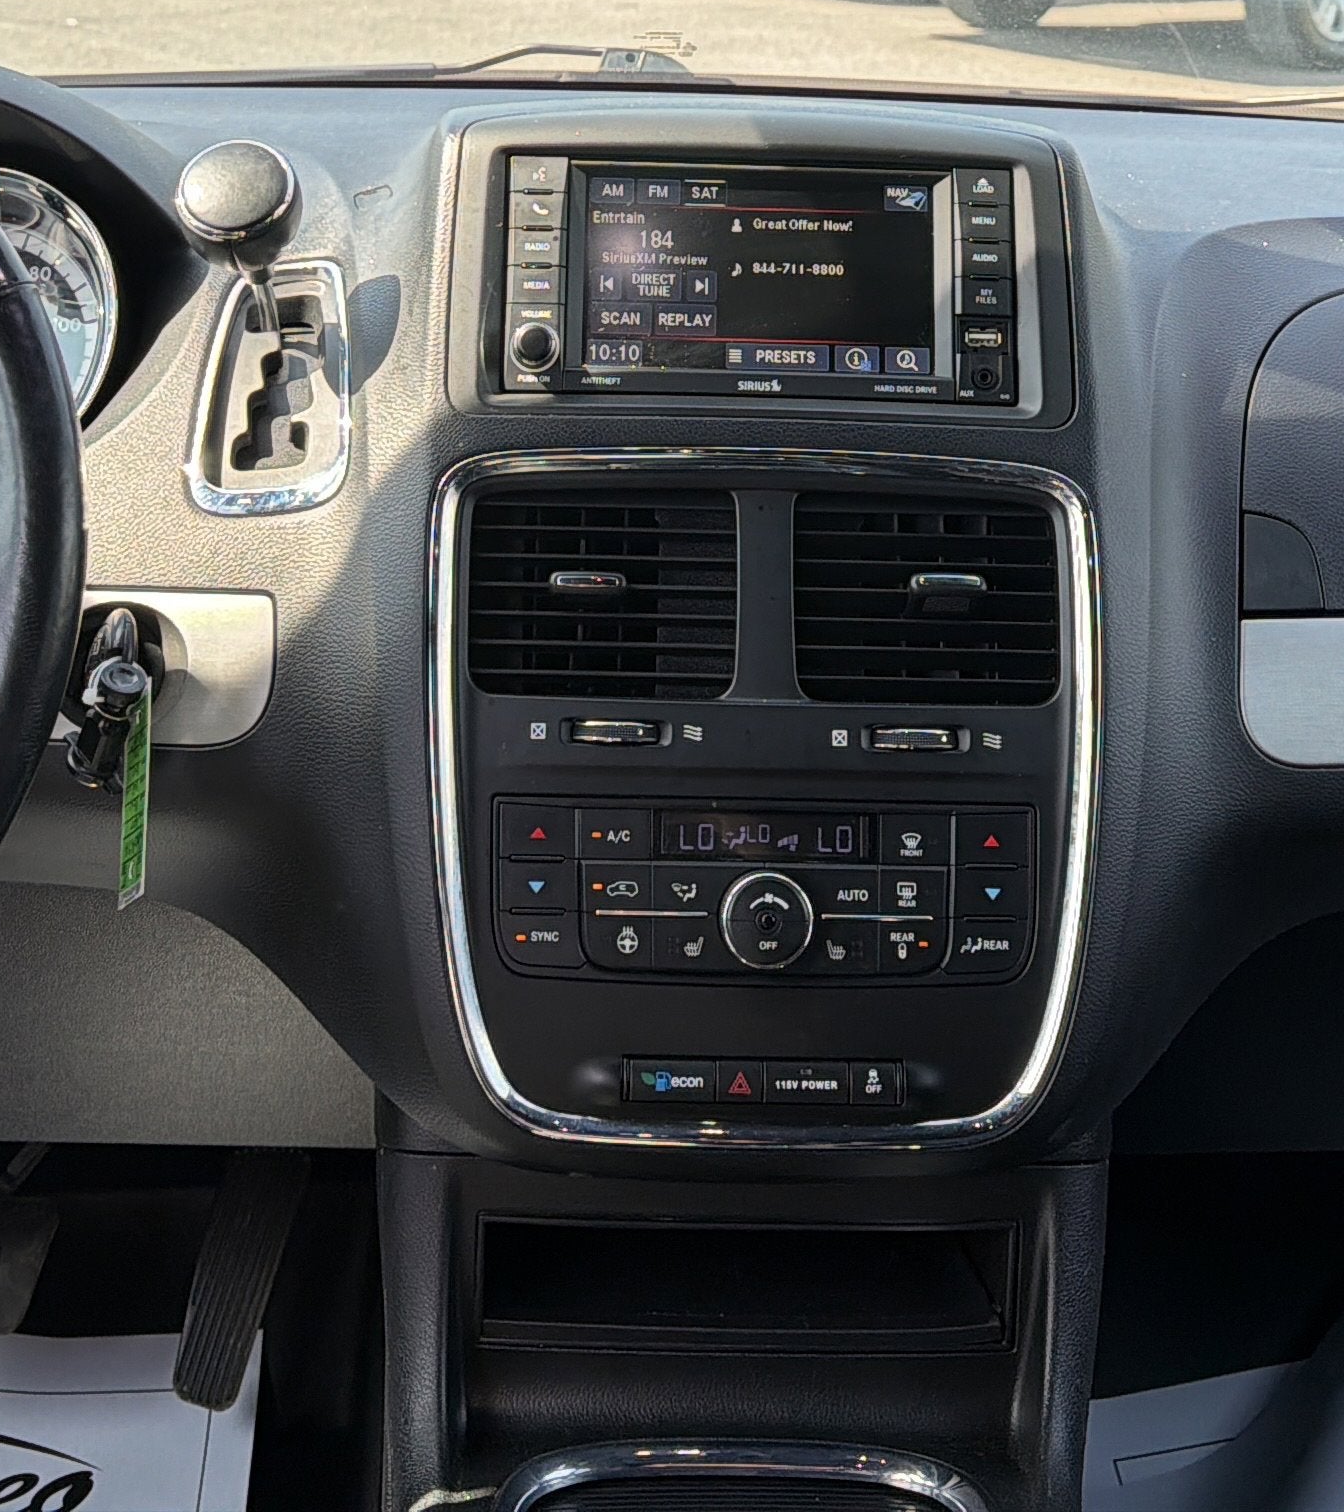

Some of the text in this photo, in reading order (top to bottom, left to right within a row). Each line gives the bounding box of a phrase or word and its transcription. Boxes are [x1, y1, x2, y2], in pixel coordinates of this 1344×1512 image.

[601, 184, 625, 198] AM
[648, 185, 669, 198] FM
[690, 186, 719, 200] SAT
[886, 187, 909, 198] NAV
[972, 184, 994, 194] LOAD
[592, 210, 646, 225] Entrtain
[971, 216, 997, 226] MENU
[752, 217, 854, 232] Great Offer Now!
[638, 229, 675, 250] 184
[524, 242, 551, 252] RADIO
[601, 252, 709, 267] SiriusXM Preview
[971, 253, 998, 263] AUDIO
[29, 265, 52, 282] 80
[752, 261, 845, 277] 844-711-8800
[522, 281, 551, 290] MEDIA
[631, 273, 677, 287] DIRECT
[637, 285, 671, 298] TUNE
[979, 288, 993, 297] MY
[975, 296, 997, 305] FILES
[520, 309, 553, 319] VOLUME
[600, 311, 641, 326] SCAN
[657, 312, 713, 328] REPLAY
[588, 344, 641, 362] 10:10
[754, 349, 816, 365] PRESETS
[580, 376, 622, 385] ANTITHEFT
[737, 380, 772, 392] SIRIUS
[873, 384, 938, 394] HARD DISC DRIVE
[958, 389, 975, 398] AUX
[606, 829, 631, 843] A/C
[900, 849, 923, 858] FRONT
[837, 889, 869, 902] AUTO
[898, 900, 917, 908] REAR
[530, 931, 560, 943] SYNC
[889, 932, 915, 943] REAR
[758, 940, 778, 951] OFF
[982, 939, 1010, 951] REAR
[671, 1075, 704, 1089] econ
[775, 1080, 838, 1090] 115V POWER
[865, 1084, 882, 1094] OFF
